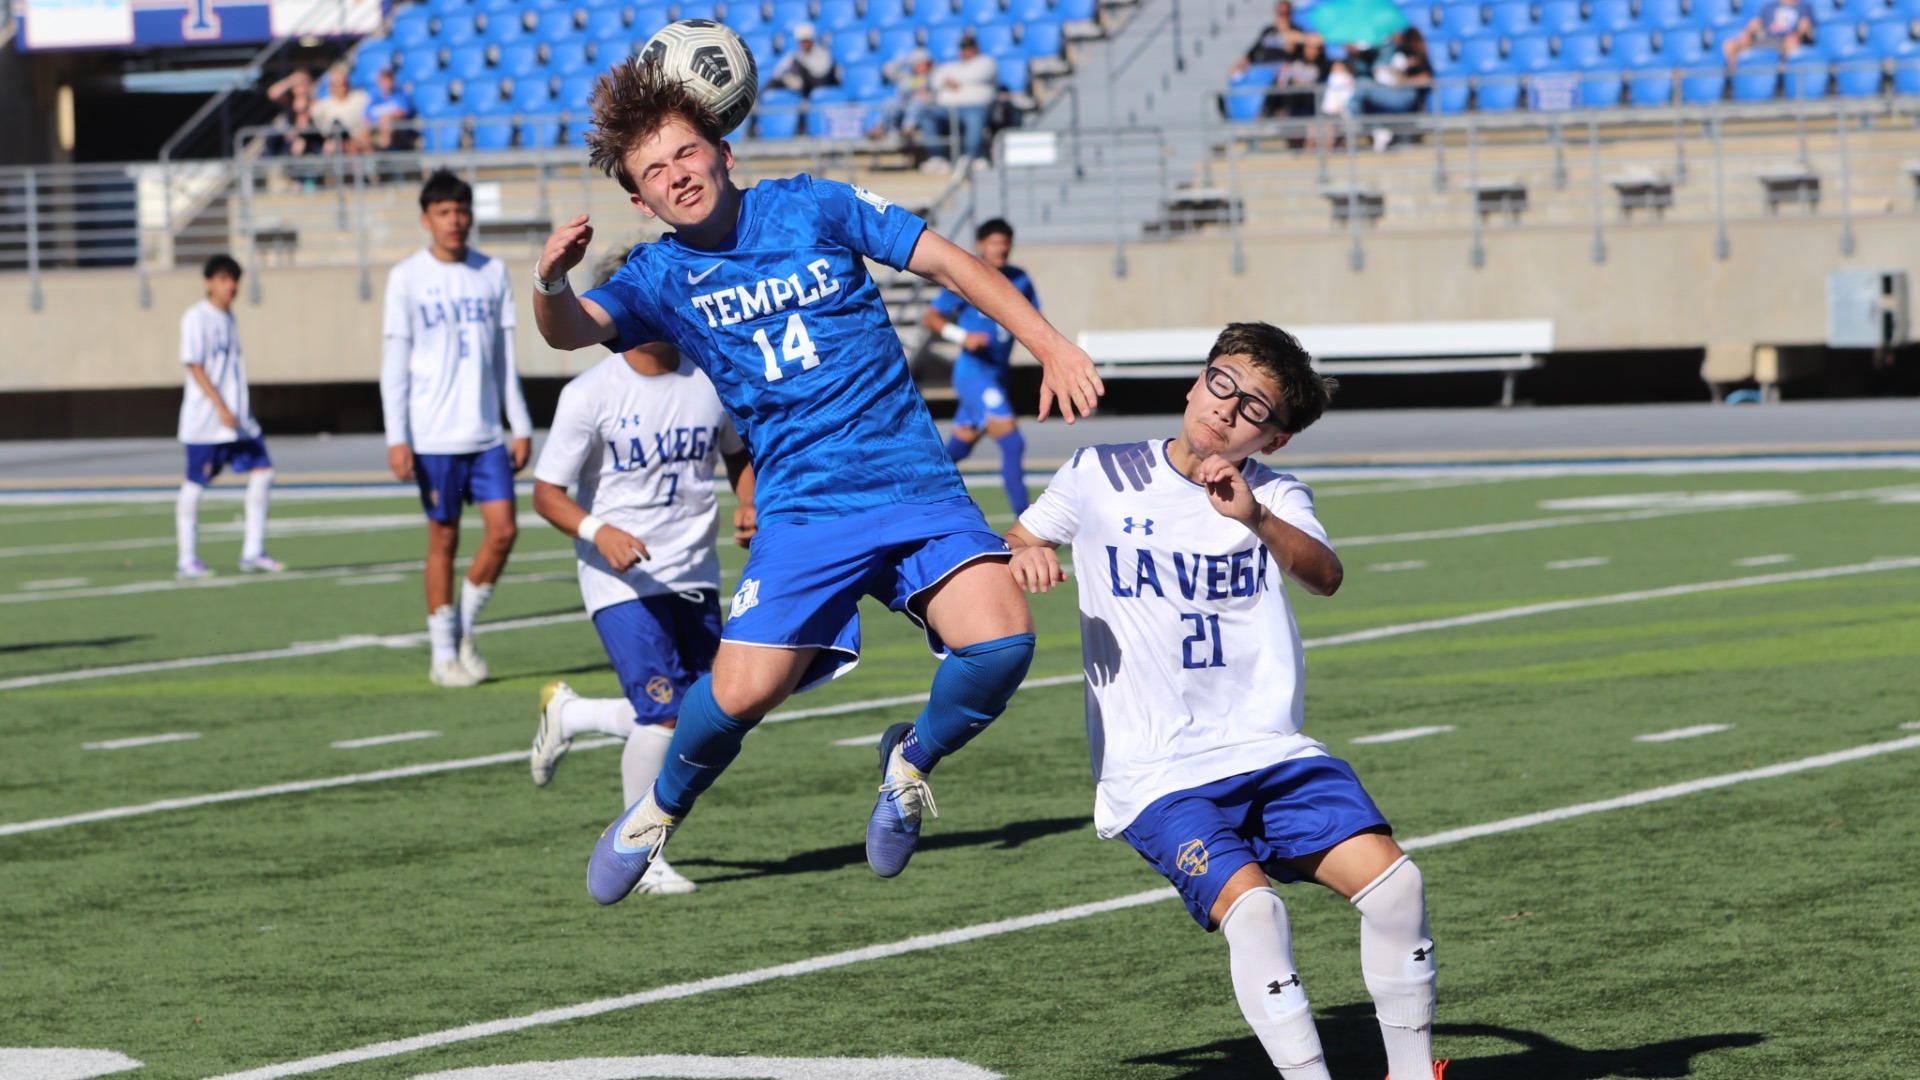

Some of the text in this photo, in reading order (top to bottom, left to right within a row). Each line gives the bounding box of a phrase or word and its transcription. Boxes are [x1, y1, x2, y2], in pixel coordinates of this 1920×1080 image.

[420, 302, 447, 328] LA
[691, 258, 840, 328] TEMPLE
[752, 312, 821, 382] 14
[608, 437, 647, 471] LA
[661, 473, 679, 507] 7
[1105, 543, 1269, 601] LA VEGA
[1180, 613, 1227, 669] 21
